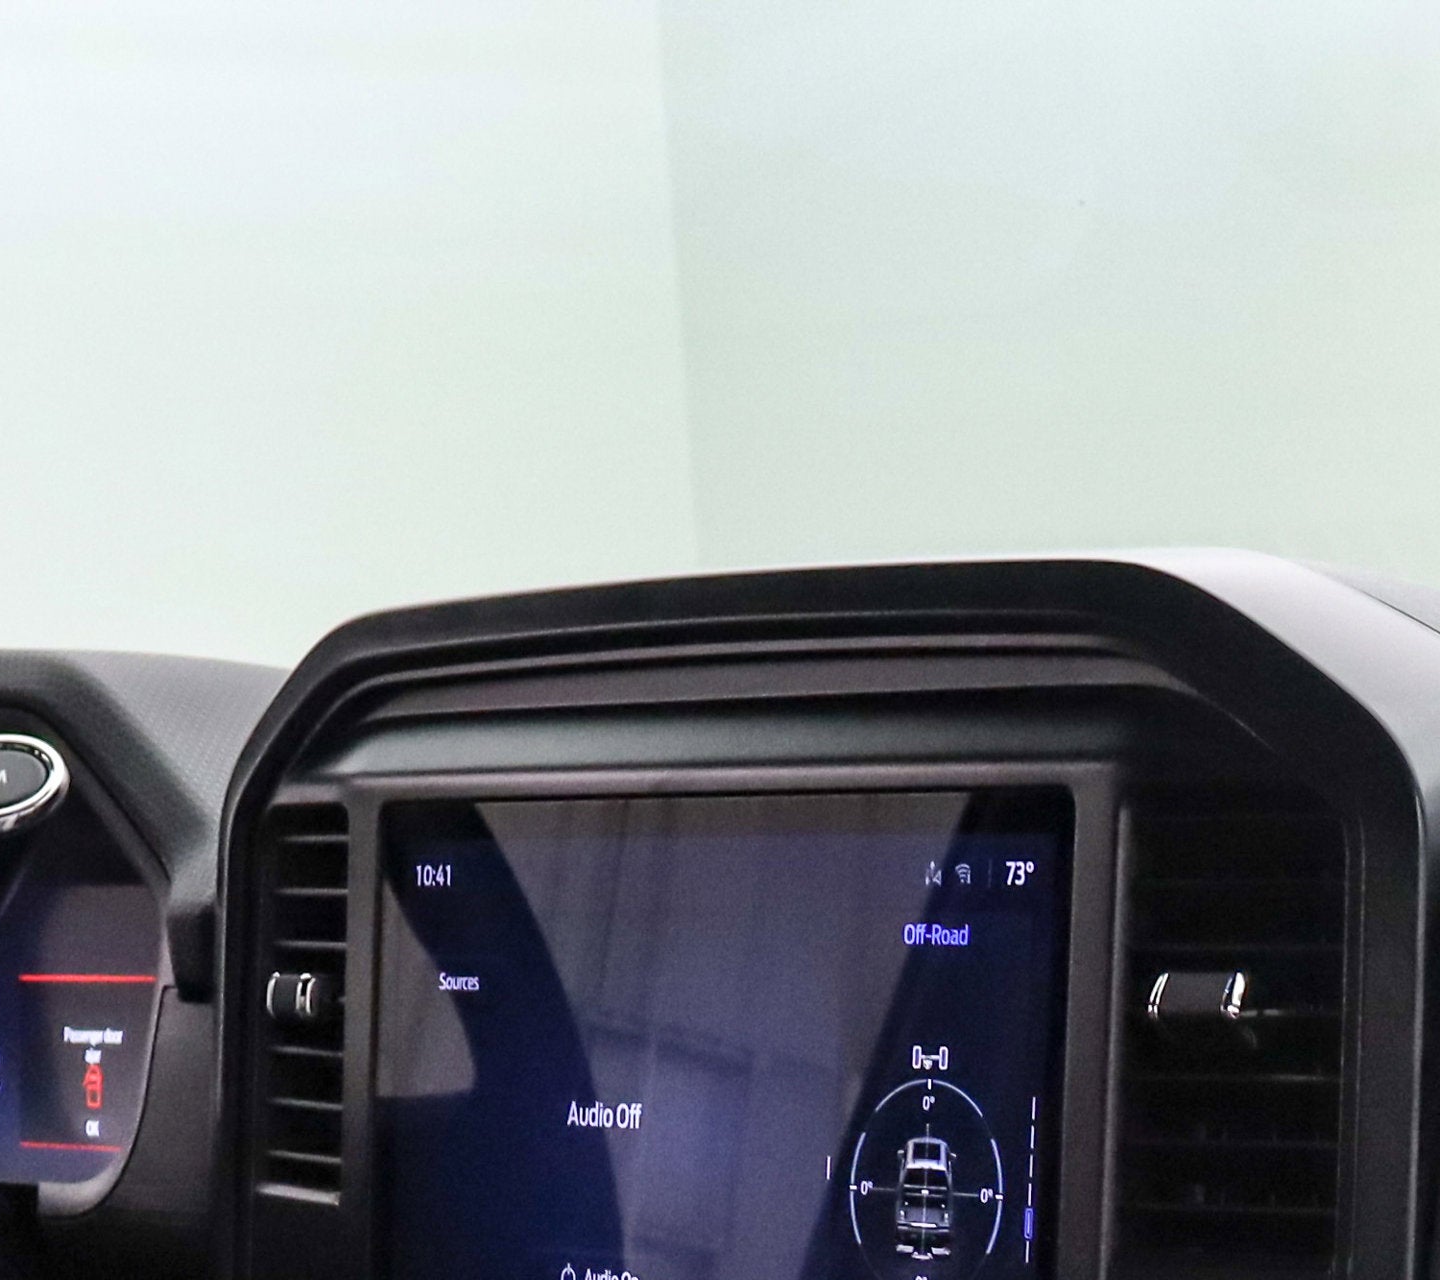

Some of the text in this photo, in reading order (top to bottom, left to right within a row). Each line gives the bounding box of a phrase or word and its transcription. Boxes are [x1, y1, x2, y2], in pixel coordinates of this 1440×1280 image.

[415, 865, 452, 887] 10:41
[1005, 861, 1034, 886] 73°
[903, 924, 970, 946] Off-Road
[438, 973, 480, 992] Sources
[567, 1102, 642, 1131] Audio Off
